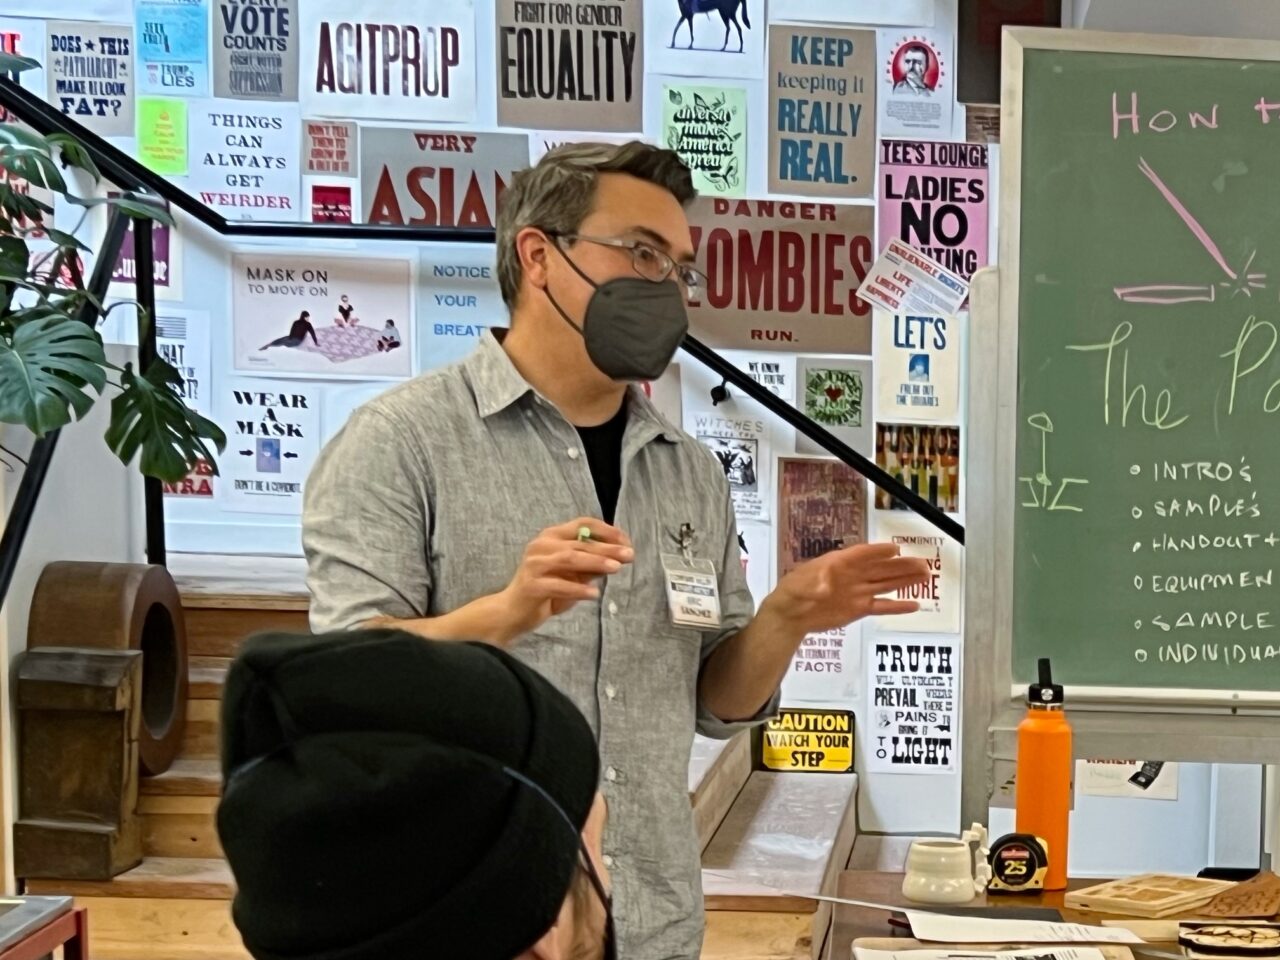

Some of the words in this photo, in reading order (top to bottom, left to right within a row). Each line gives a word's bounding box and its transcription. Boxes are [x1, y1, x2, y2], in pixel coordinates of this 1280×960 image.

[221, 4, 290, 37] VOTE
[514, 1, 546, 24] FIGHT
[549, 3, 573, 25] FOR
[576, 4, 622, 26] GENDER
[51, 34, 82, 53] DOES
[98, 36, 129, 56] THIS
[223, 35, 288, 51] COUNTS
[791, 35, 854, 68] KEEP
[316, 22, 459, 98] AGITPROP
[500, 26, 636, 103] EQUALITY
[56, 79, 86, 95] MAKE
[100, 81, 126, 97] LOOK
[161, 73, 195, 88] LIES
[778, 72, 847, 96] keeping
[60, 97, 122, 117] FAT?
[208, 113, 283, 130] THINGS
[778, 98, 863, 137] REALLY
[225, 134, 263, 149] CAN
[414, 133, 477, 154] VERY
[203, 152, 287, 169] ALWAYS
[778, 139, 858, 184] REAL.
[930, 142, 989, 169] LOUNGE
[225, 174, 264, 188] GET
[885, 174, 985, 203] LADIES
[199, 192, 292, 209] WEIRDER
[714, 199, 837, 222] DANGER
[900, 201, 968, 247] NO
[246, 267, 297, 283] MASK
[302, 269, 328, 284] ON
[433, 264, 491, 279] NOTICE
[892, 270, 914, 288] LIFE
[248, 283, 265, 294] TO
[269, 284, 305, 297] MOVE
[309, 286, 328, 297] ON
[434, 294, 478, 307] YOUR
[433, 323, 486, 337] BREAT
[751, 328, 799, 342] RUN.
[894, 315, 947, 351] LET'S
[1065, 320, 1189, 429] The
[233, 390, 309, 409] WEAR
[262, 407, 278, 423] A
[694, 416, 765, 433] WITCHES
[235, 420, 304, 438] MASK
[1152, 532, 1261, 552] HANDOUT
[1151, 611, 1276, 632] SAMPLE
[795, 660, 842, 673] FACTS
[876, 644, 953, 674] TRUTH
[874, 687, 919, 708] PREVAIL
[768, 713, 849, 732] CAUTION
[895, 711, 938, 723] PAINS
[766, 732, 810, 748] WATCH
[815, 734, 850, 748] YOUR
[790, 750, 826, 767] STEP
[891, 736, 953, 766] LIGHT
[1004, 859, 1028, 876] 25
